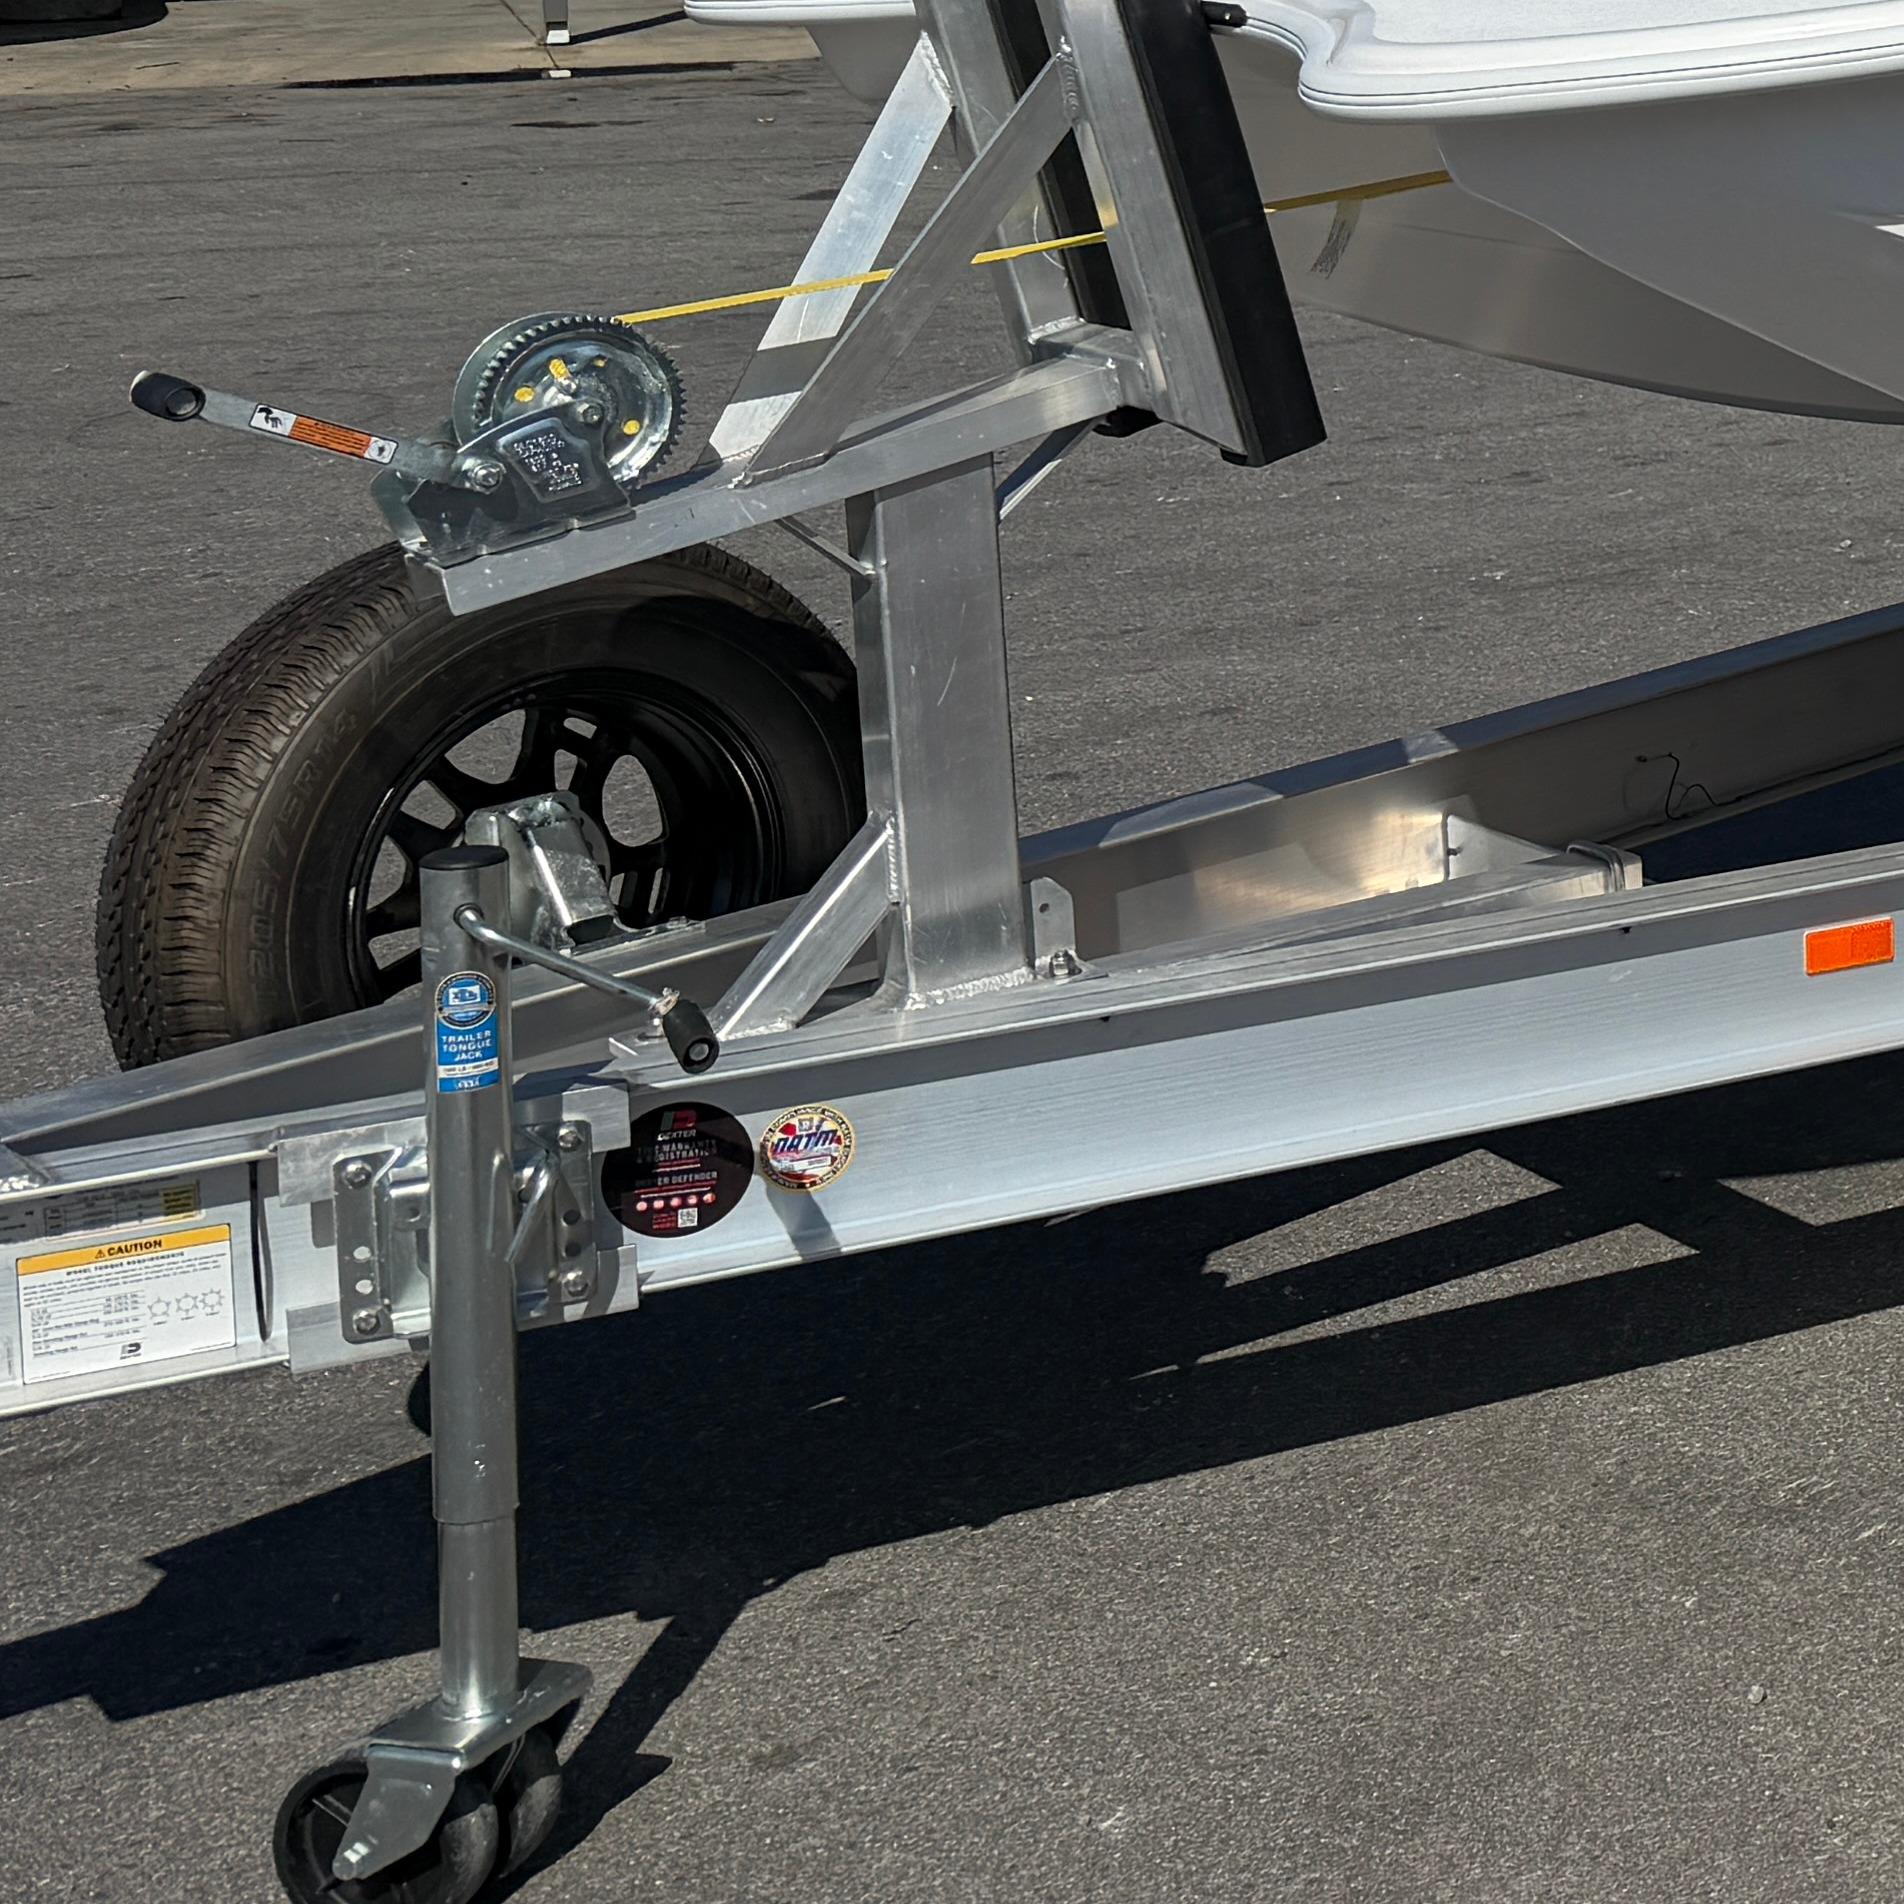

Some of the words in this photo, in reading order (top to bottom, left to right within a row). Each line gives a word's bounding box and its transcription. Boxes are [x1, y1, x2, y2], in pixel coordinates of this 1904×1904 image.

[441, 1029, 492, 1044] TRAILER
[442, 1038, 493, 1053] TONGUE
[453, 1050, 483, 1062] JACK
[107, 1239, 163, 1257] CAUTION
